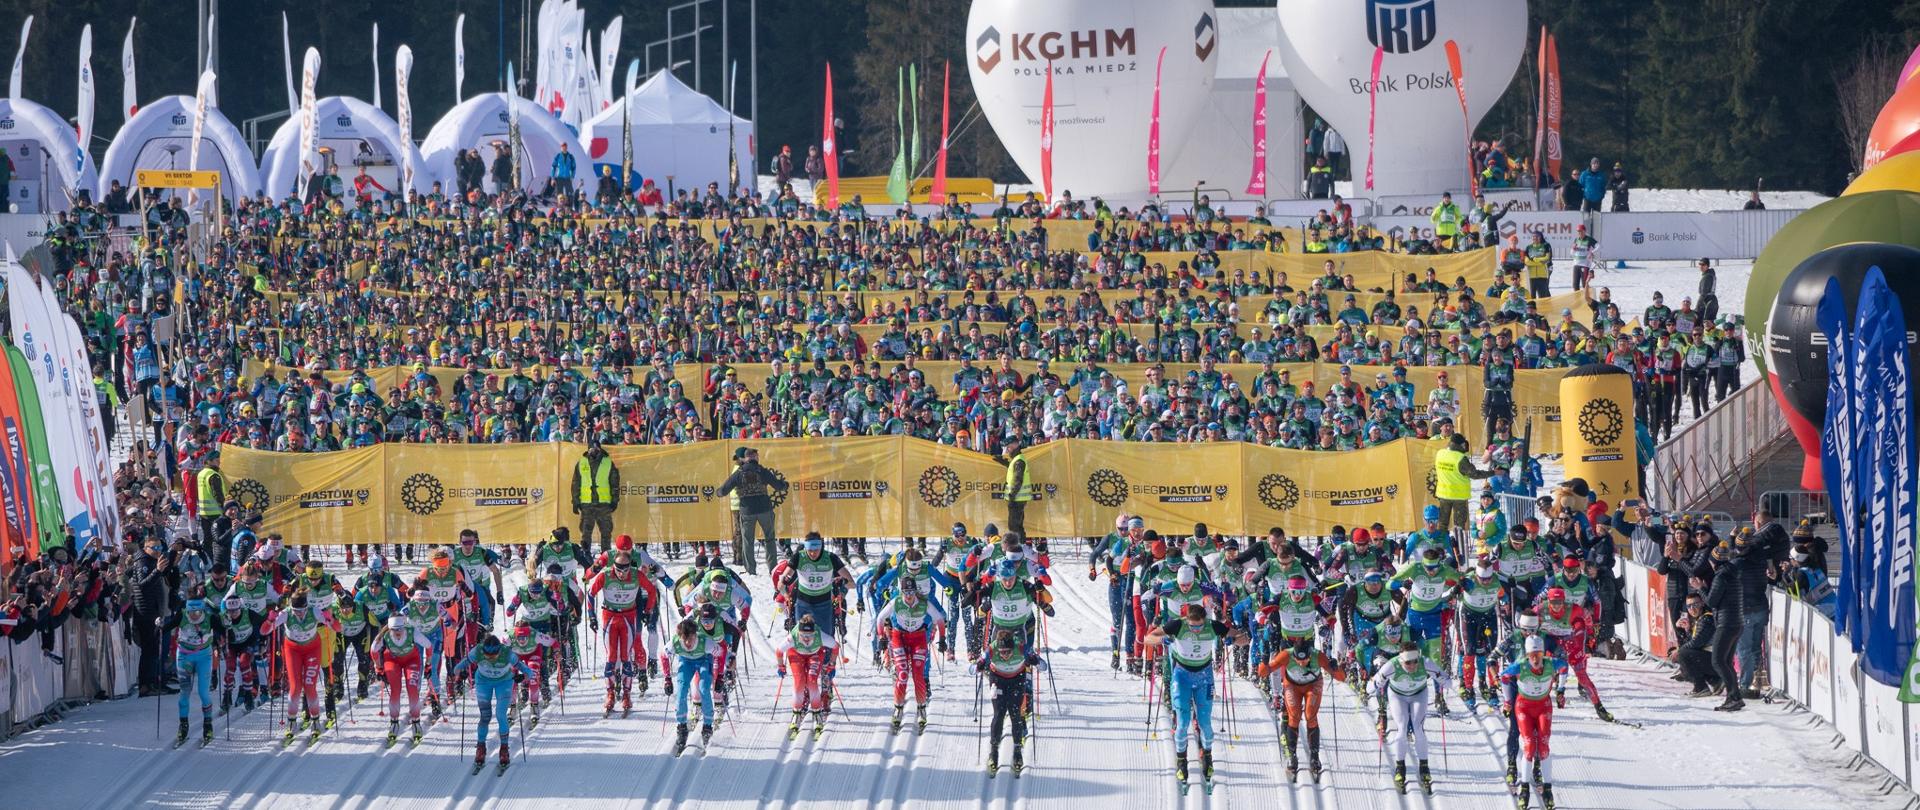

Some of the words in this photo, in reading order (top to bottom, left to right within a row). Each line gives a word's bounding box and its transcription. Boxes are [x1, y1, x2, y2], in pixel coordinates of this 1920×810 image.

[1012, 27, 1136, 61] KGHM
[1085, 62, 1136, 74] MIEDŹ
[1406, 70, 1455, 91] Polsk
[1523, 222, 1572, 233] KGHM
[1649, 233, 1669, 241] Bank
[1673, 232, 1697, 241] Polski
[793, 480, 872, 491] BIEGPIASTÓW
[1132, 485, 1212, 495] BIEGPIASTÓW
[448, 487, 528, 497] BIEGPIASTÓW
[1303, 487, 1383, 499] BIEGPIASTÓW
[1421, 587, 1436, 595] 19
[1193, 645, 1201, 653] 2
[306, 664, 319, 685] POL
